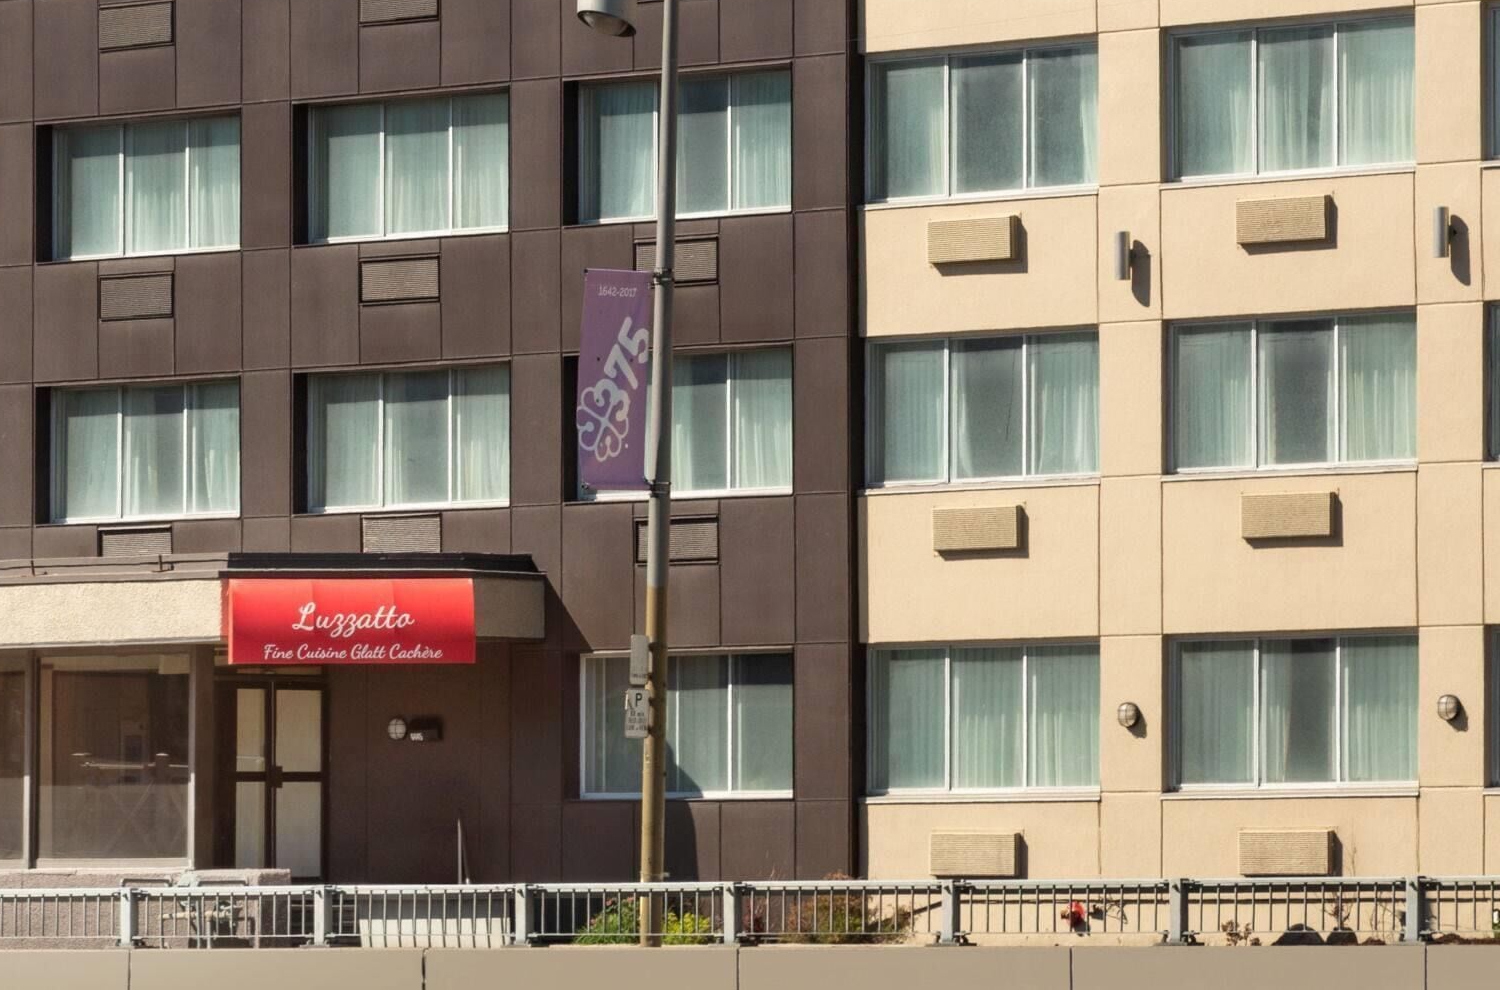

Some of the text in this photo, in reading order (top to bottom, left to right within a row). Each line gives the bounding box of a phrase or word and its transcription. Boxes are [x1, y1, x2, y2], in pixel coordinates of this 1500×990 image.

[597, 285, 638, 298] 1642-2017
[594, 316, 649, 421] 375
[291, 601, 415, 638] Luzzatto
[263, 643, 443, 660] Fine Cuisine Glatt Cachère
[635, 692, 643, 708] P
